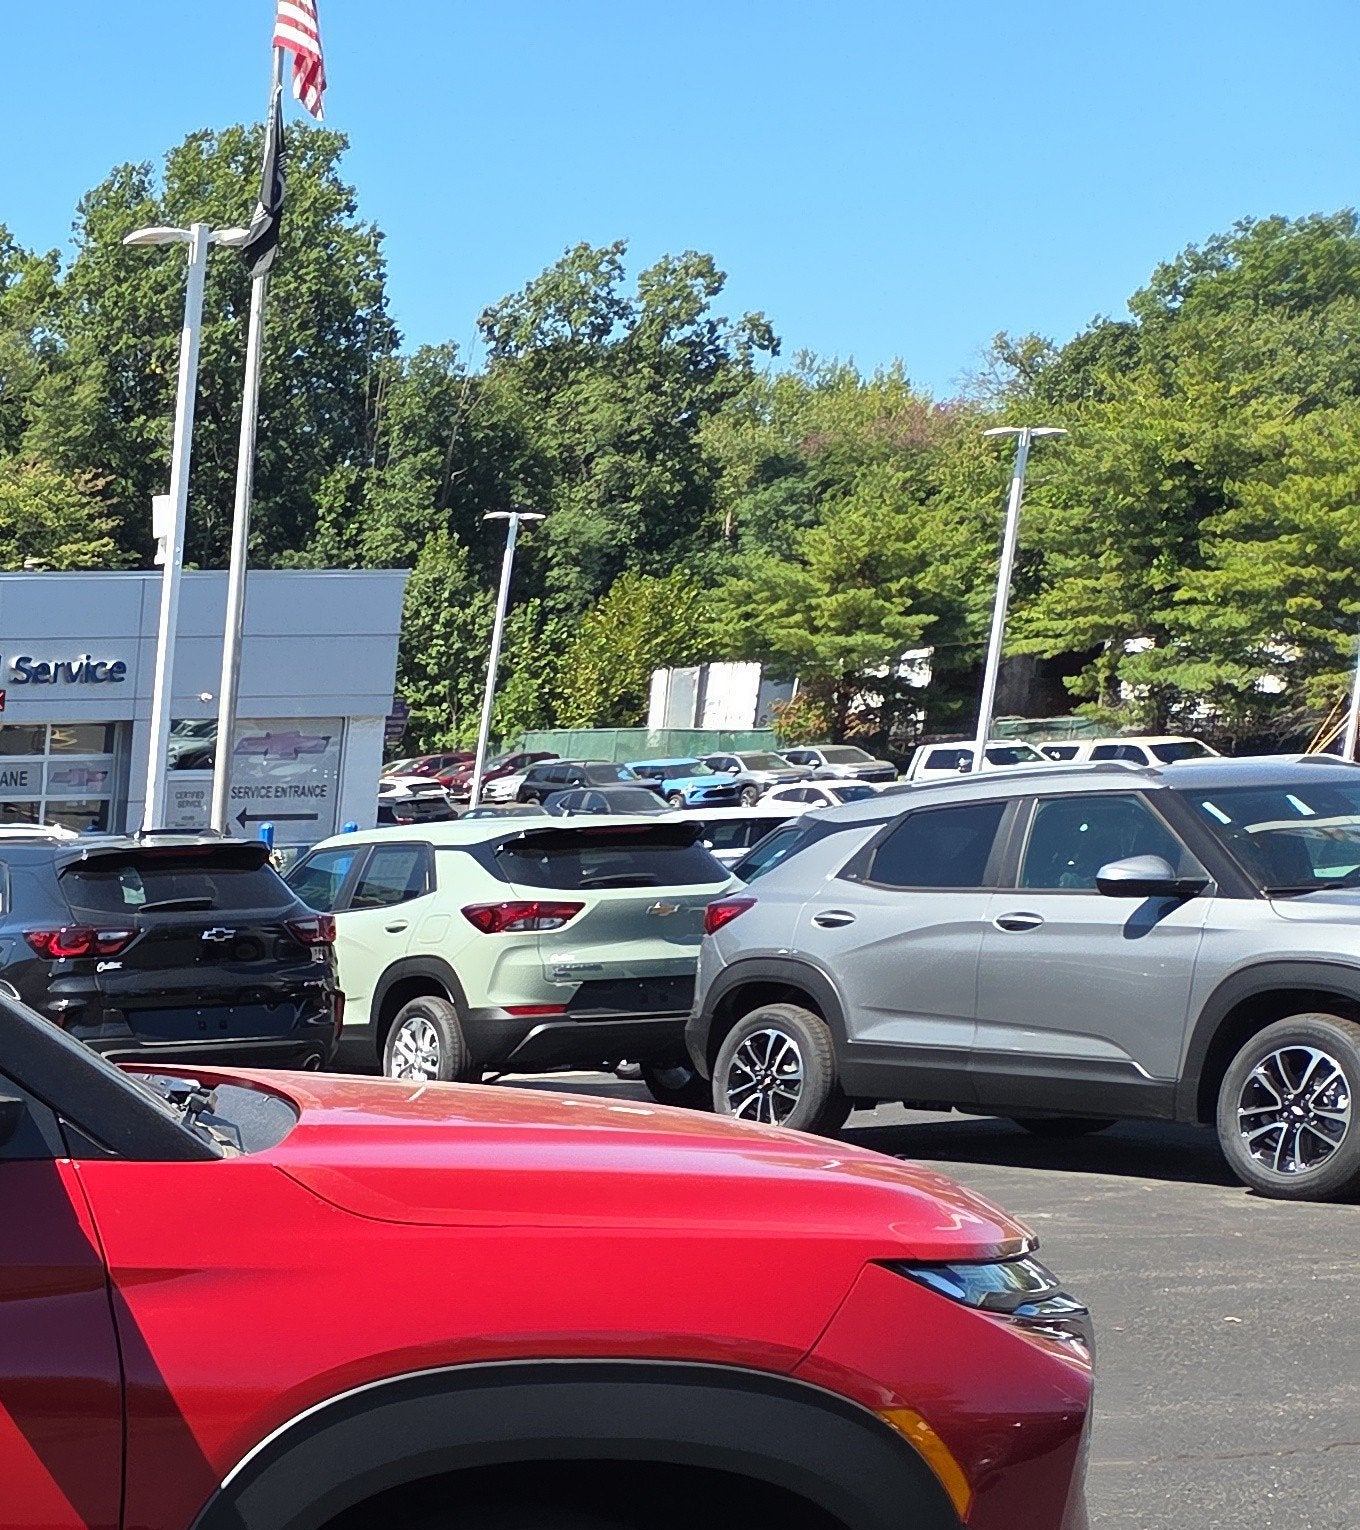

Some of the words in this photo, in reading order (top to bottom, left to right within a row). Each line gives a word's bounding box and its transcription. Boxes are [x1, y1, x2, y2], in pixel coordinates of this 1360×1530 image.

[9, 653, 128, 686] Service
[230, 786, 273, 799] SERVICE
[273, 784, 327, 798] ENTRANCE
